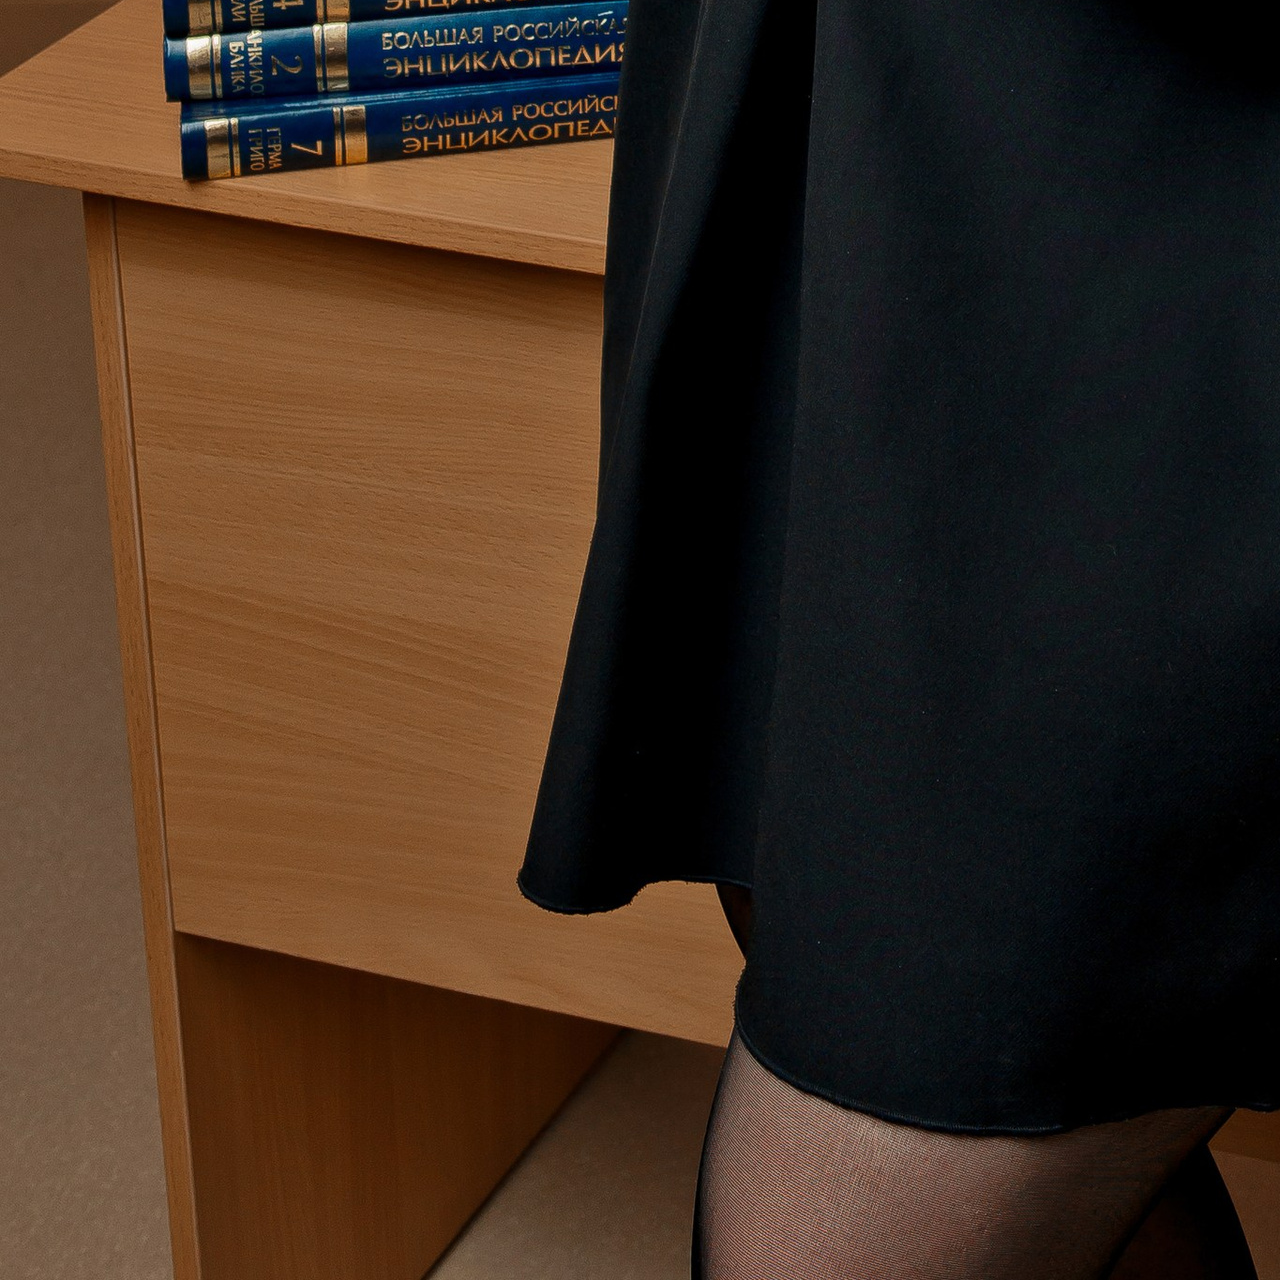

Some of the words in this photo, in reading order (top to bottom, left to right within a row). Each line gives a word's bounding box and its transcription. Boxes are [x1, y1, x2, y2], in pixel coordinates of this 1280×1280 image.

[381, 26, 484, 50] БОЛЬШАЯ
[228, 41, 247, 93] БАНКА
[270, 55, 303, 76] 2
[401, 107, 504, 133] БОЛЬШАЯ
[248, 128, 266, 171] ГРИГО
[266, 127, 283, 170] ГЕРМА
[290, 140, 323, 156] 7
[402, 118, 615, 155] ЭНЦИКЛОПЕД
